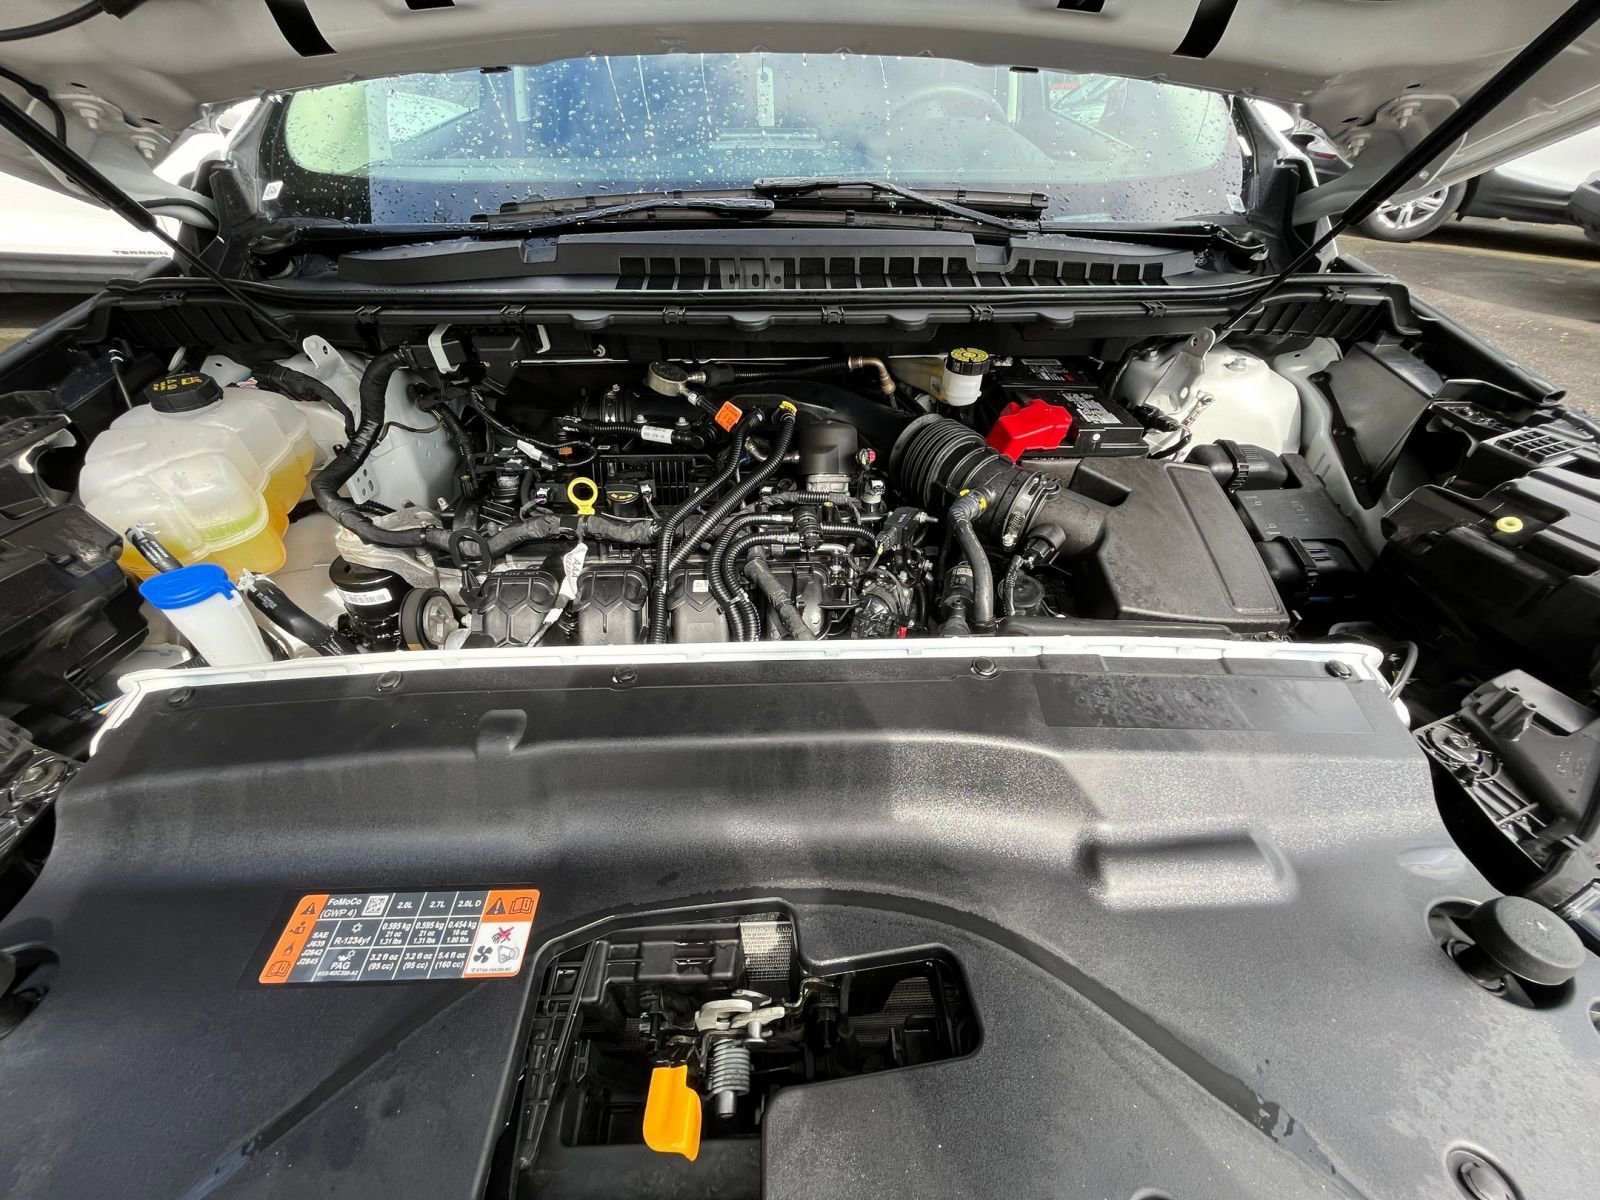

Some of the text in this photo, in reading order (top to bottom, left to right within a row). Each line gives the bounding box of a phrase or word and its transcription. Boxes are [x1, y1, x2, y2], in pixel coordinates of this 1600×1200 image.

[328, 897, 362, 905] FoMoCo
[457, 900, 474, 908] 2.0L
[320, 908, 358, 919] (GWP 4)
[401, 922, 412, 931] kg
[435, 922, 445, 931] kg
[448, 921, 477, 930] 0.454 kg
[333, 936, 372, 947] R-1234yf
[369, 953, 382, 961] 3.2
[404, 952, 417, 960] 3.2
[330, 961, 351, 970] PAG
[382, 962, 394, 971] cc)
[402, 961, 429, 970] (95 cc)
[434, 961, 464, 970] (160 cc)
